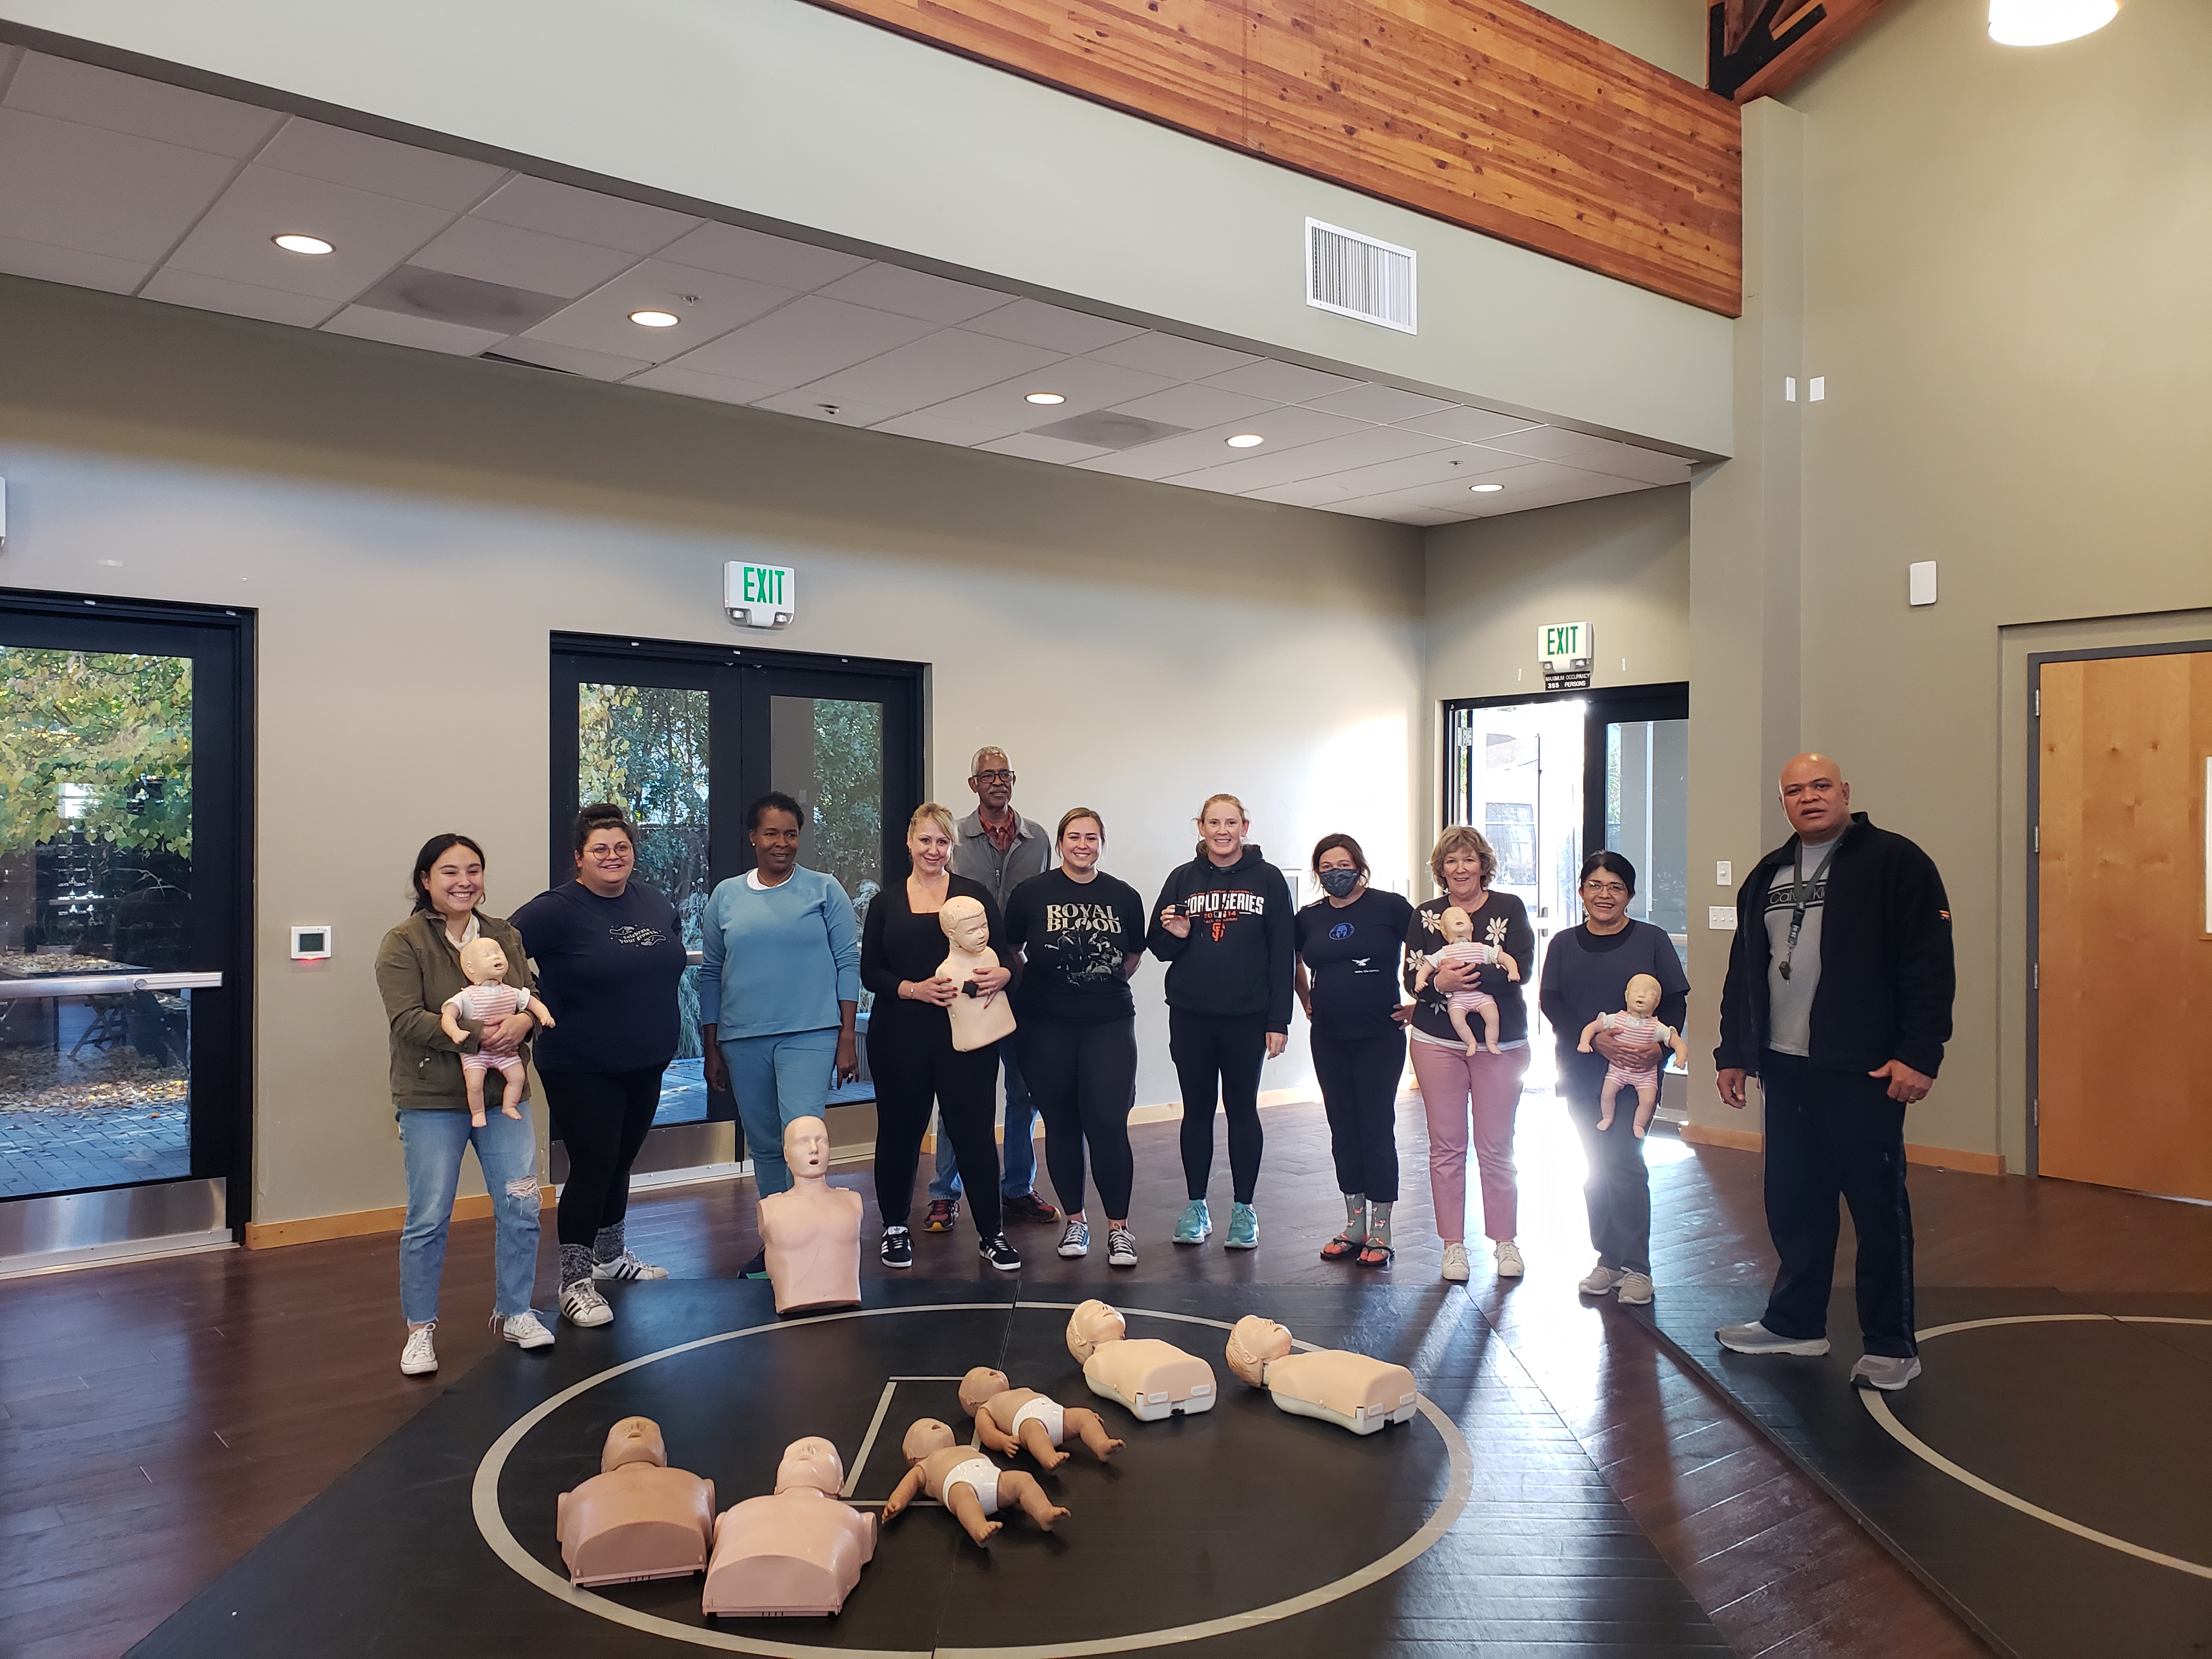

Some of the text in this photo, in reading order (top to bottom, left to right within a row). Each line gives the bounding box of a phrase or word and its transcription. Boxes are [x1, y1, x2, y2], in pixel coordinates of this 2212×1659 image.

[744, 567, 785, 605] EXIT
[1548, 626, 1578, 655] EXIT
[1047, 903, 1119, 921] ROYAL
[1222, 893, 1264, 915] SERIES
[623, 928, 650, 939] celebrate
[1047, 917, 1122, 934] BLOOD
[636, 930, 659, 941] growth
